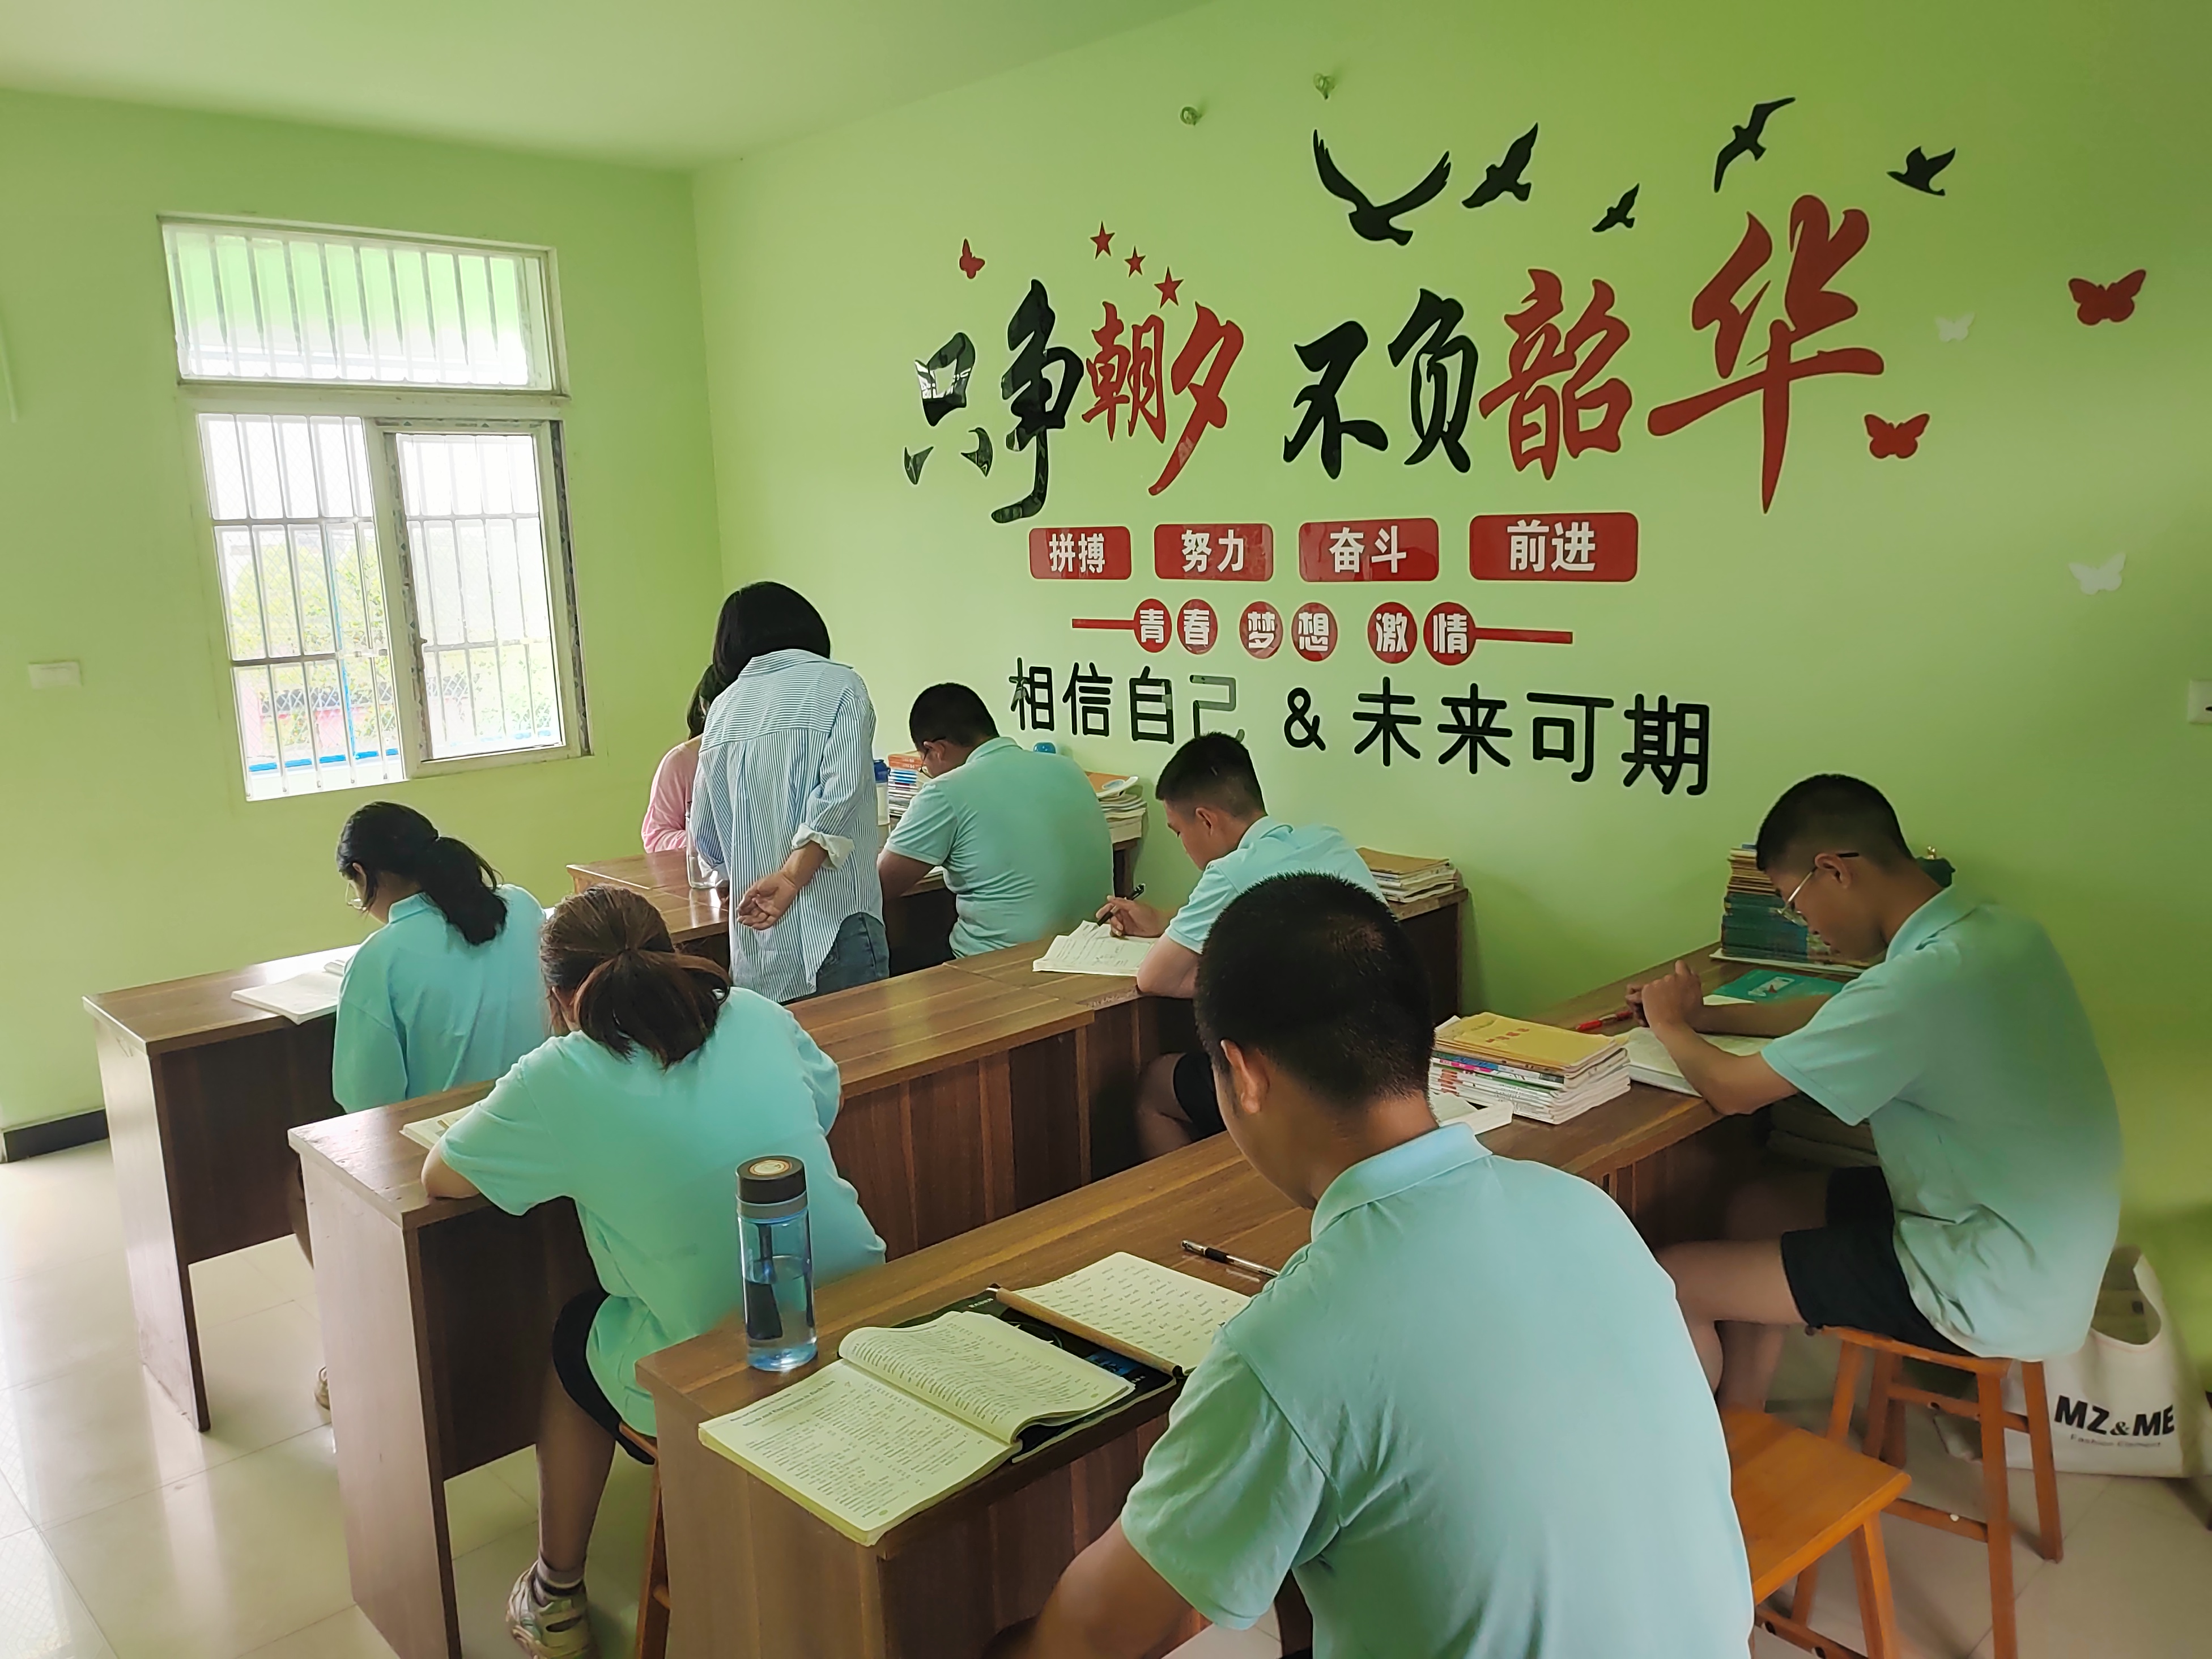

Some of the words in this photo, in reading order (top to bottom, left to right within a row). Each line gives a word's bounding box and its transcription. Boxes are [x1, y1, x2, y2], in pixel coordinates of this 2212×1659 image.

[904, 278, 1245, 524] 只争朝夕
[1283, 195, 1885, 513] 不负韶华
[1048, 531, 1107, 575] 拼搏
[1180, 530, 1245, 572] 努力
[1328, 525, 1408, 573] 奋斗
[1507, 518, 1597, 572] 前进
[1139, 608, 1211, 647] 青春
[1245, 612, 1330, 653] 梦想
[1374, 614, 1470, 654] 激情
[1009, 657, 1245, 745] 相信自己
[1284, 687, 1325, 751] &
[1353, 677, 1710, 796] 未来可期
[2054, 1395, 2175, 1436] MZ&ME
